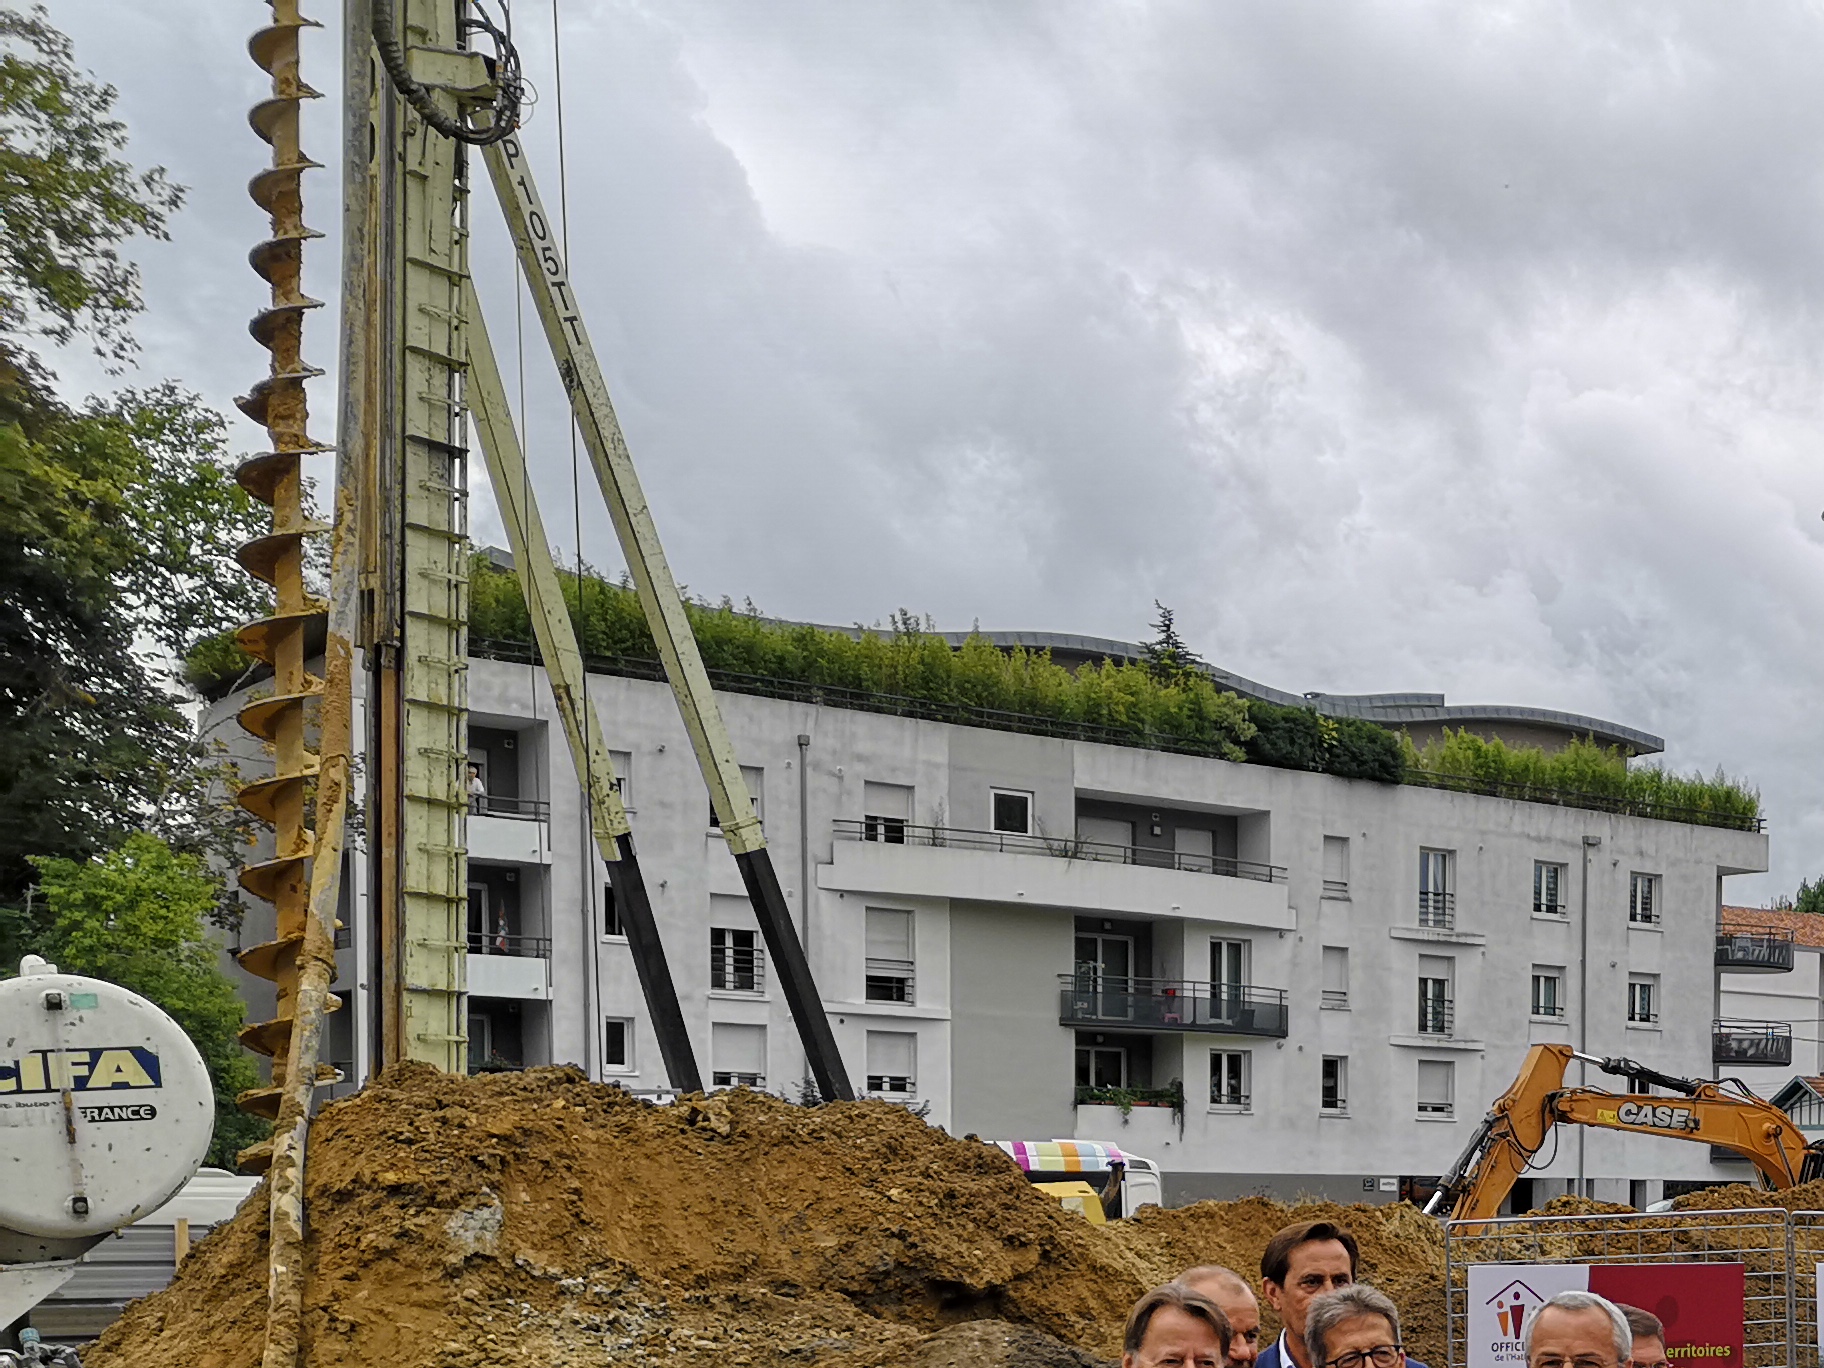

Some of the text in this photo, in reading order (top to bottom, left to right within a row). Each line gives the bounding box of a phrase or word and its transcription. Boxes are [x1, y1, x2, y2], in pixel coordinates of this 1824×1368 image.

[79, 1106, 153, 1121] FRANCE
[1618, 1102, 1690, 1129] CASE
[1666, 1343, 1731, 1358] erritoires
